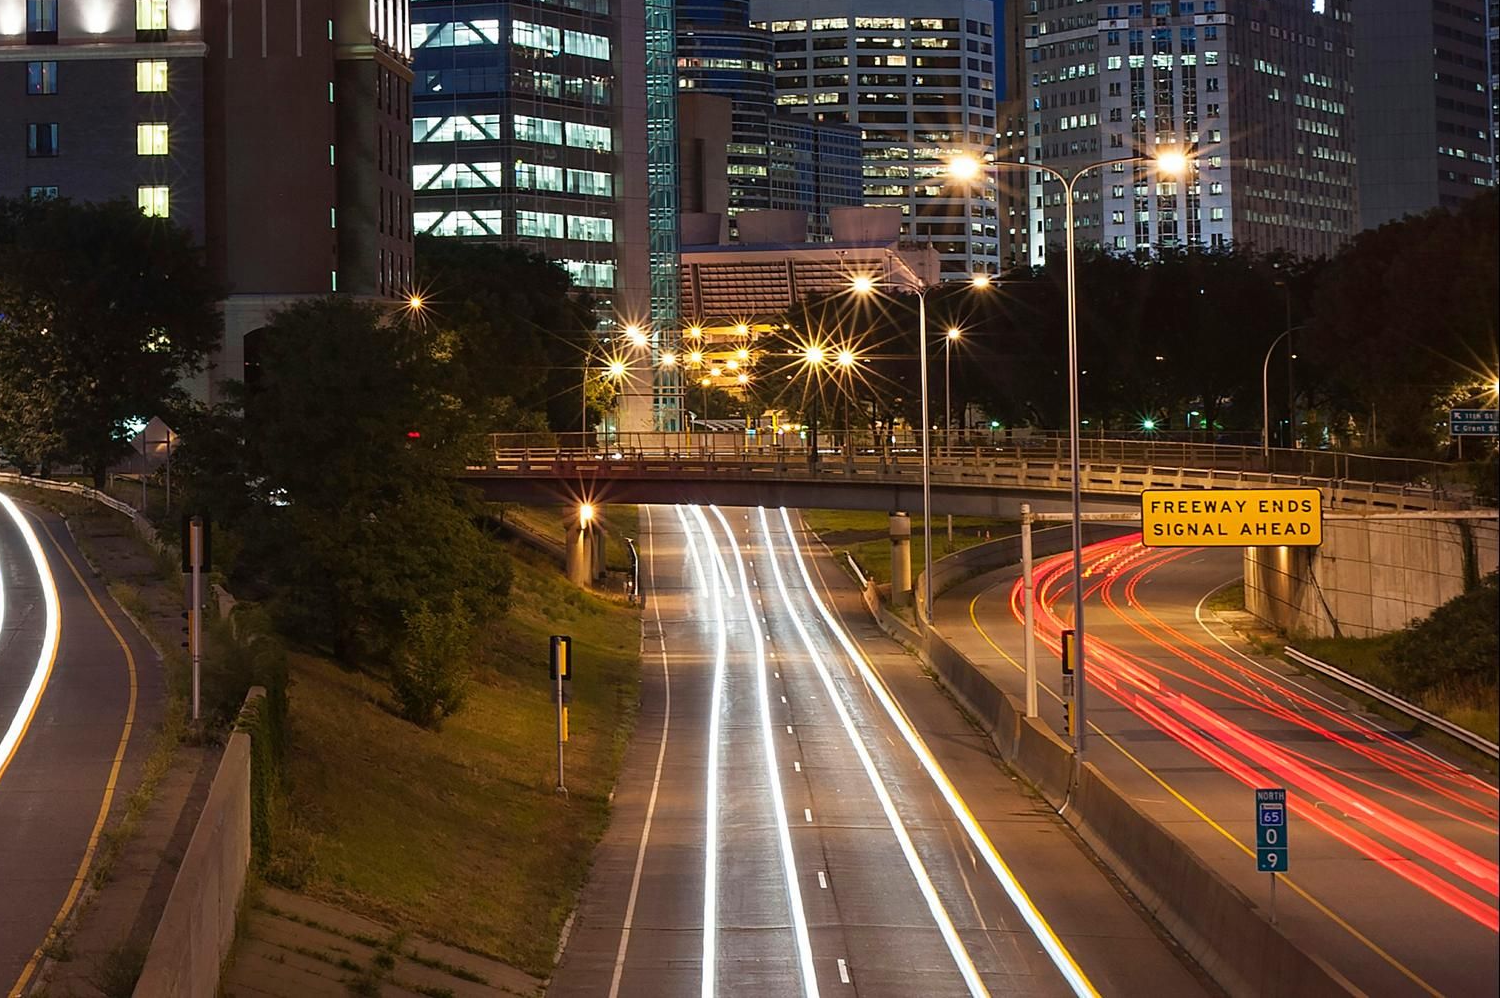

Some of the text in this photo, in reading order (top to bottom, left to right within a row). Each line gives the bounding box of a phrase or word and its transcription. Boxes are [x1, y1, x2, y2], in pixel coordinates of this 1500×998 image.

[1151, 500, 1312, 514] FREEWAY ENDS
[1153, 523, 1311, 536] SIGNAL AHEAD
[1257, 791, 1285, 800] NORTH
[1264, 811, 1280, 823] 65
[1266, 828, 1277, 844] 0
